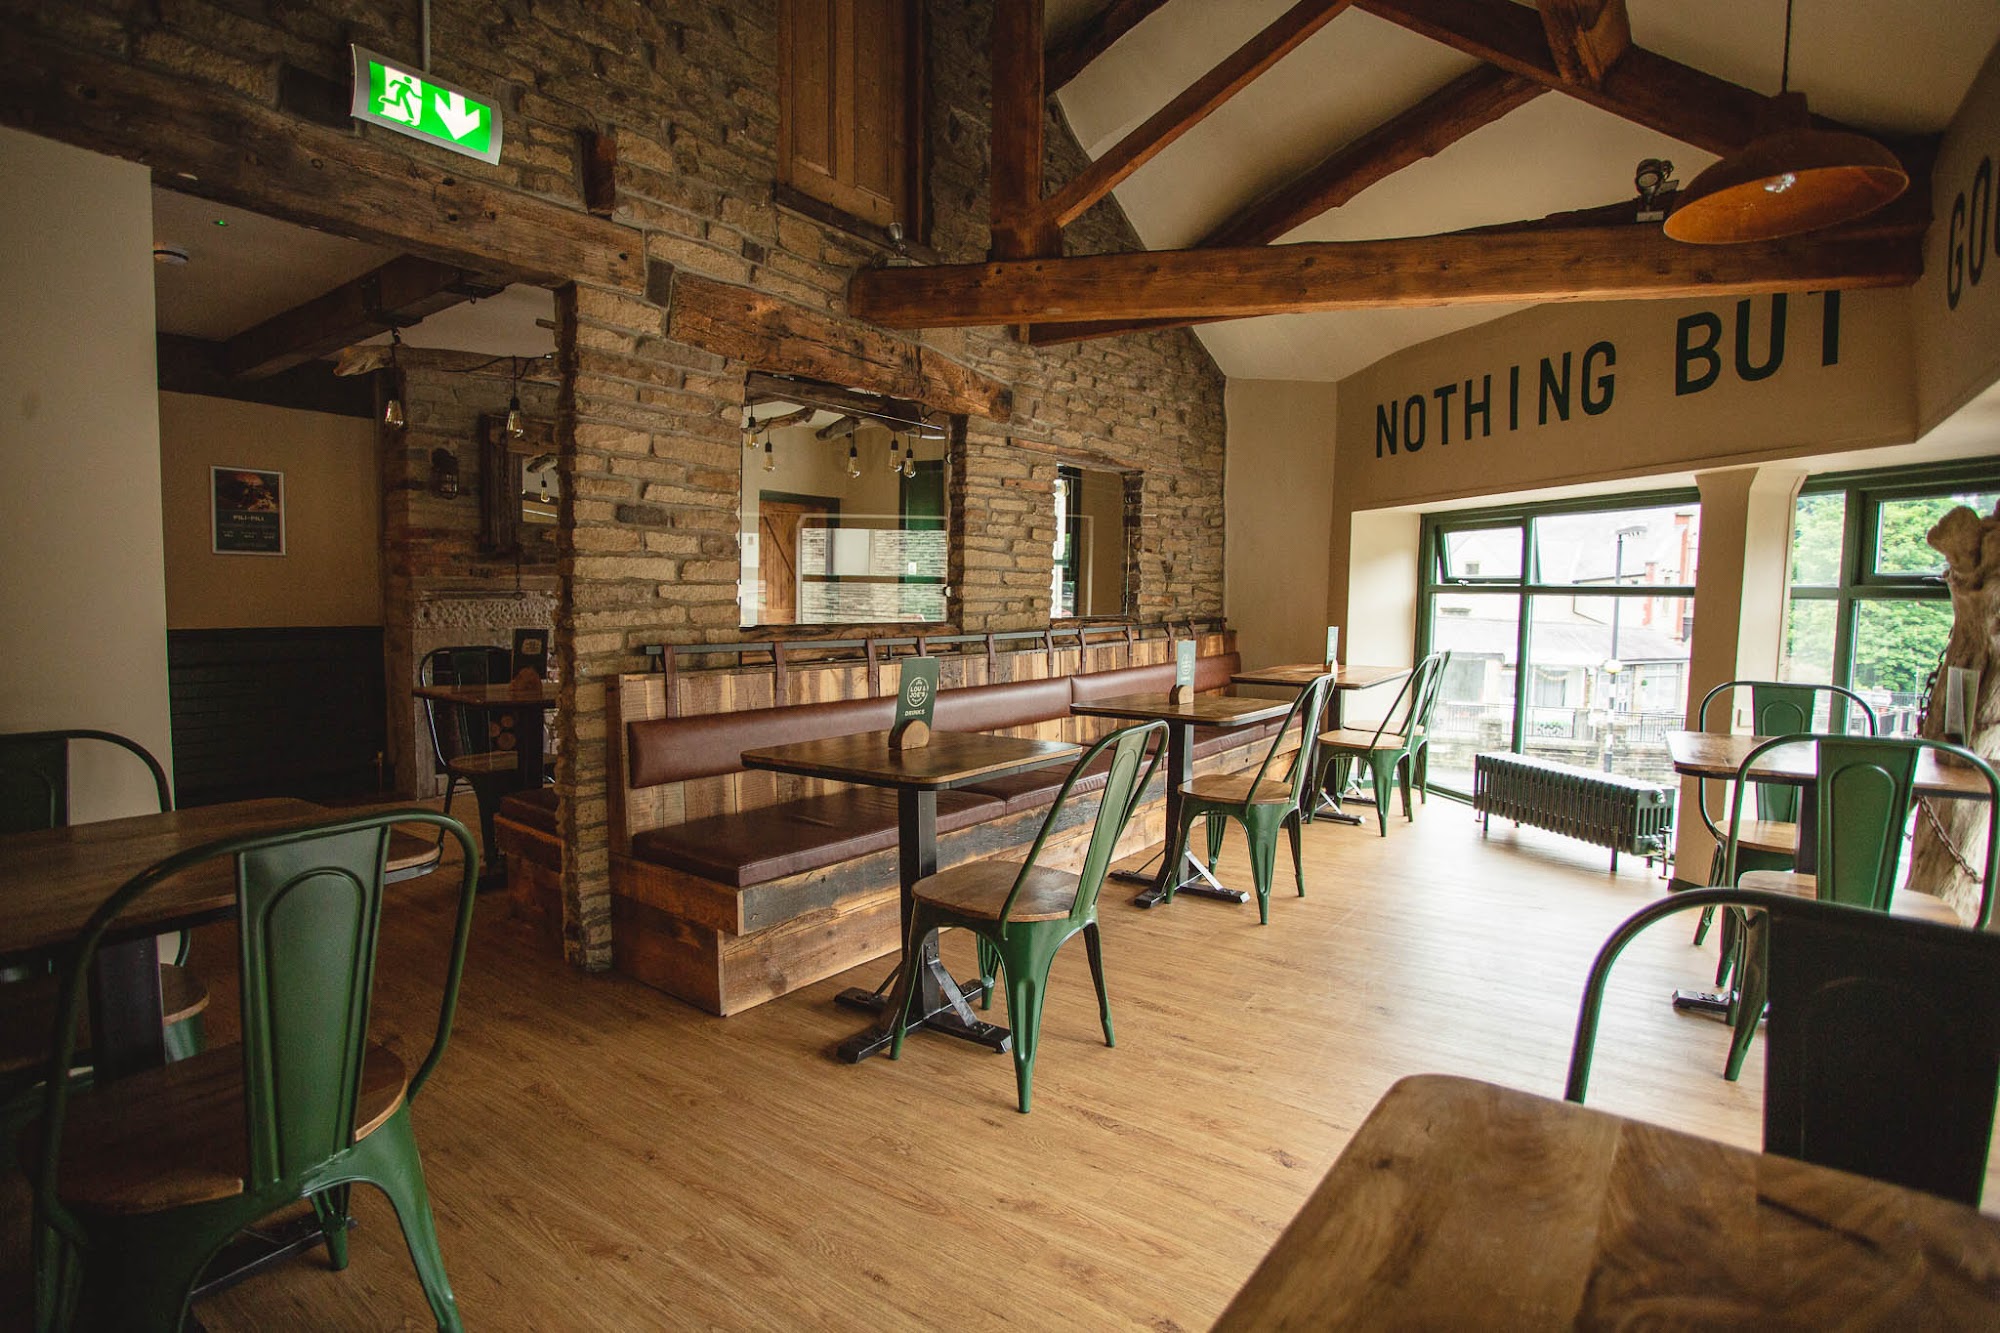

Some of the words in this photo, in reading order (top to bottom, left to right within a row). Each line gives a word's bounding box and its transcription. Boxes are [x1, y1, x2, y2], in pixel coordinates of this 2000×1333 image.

[1375, 340, 1617, 458] NOTHING
[1675, 290, 1841, 396] BUT
[904, 709, 925, 717] DRINKS
